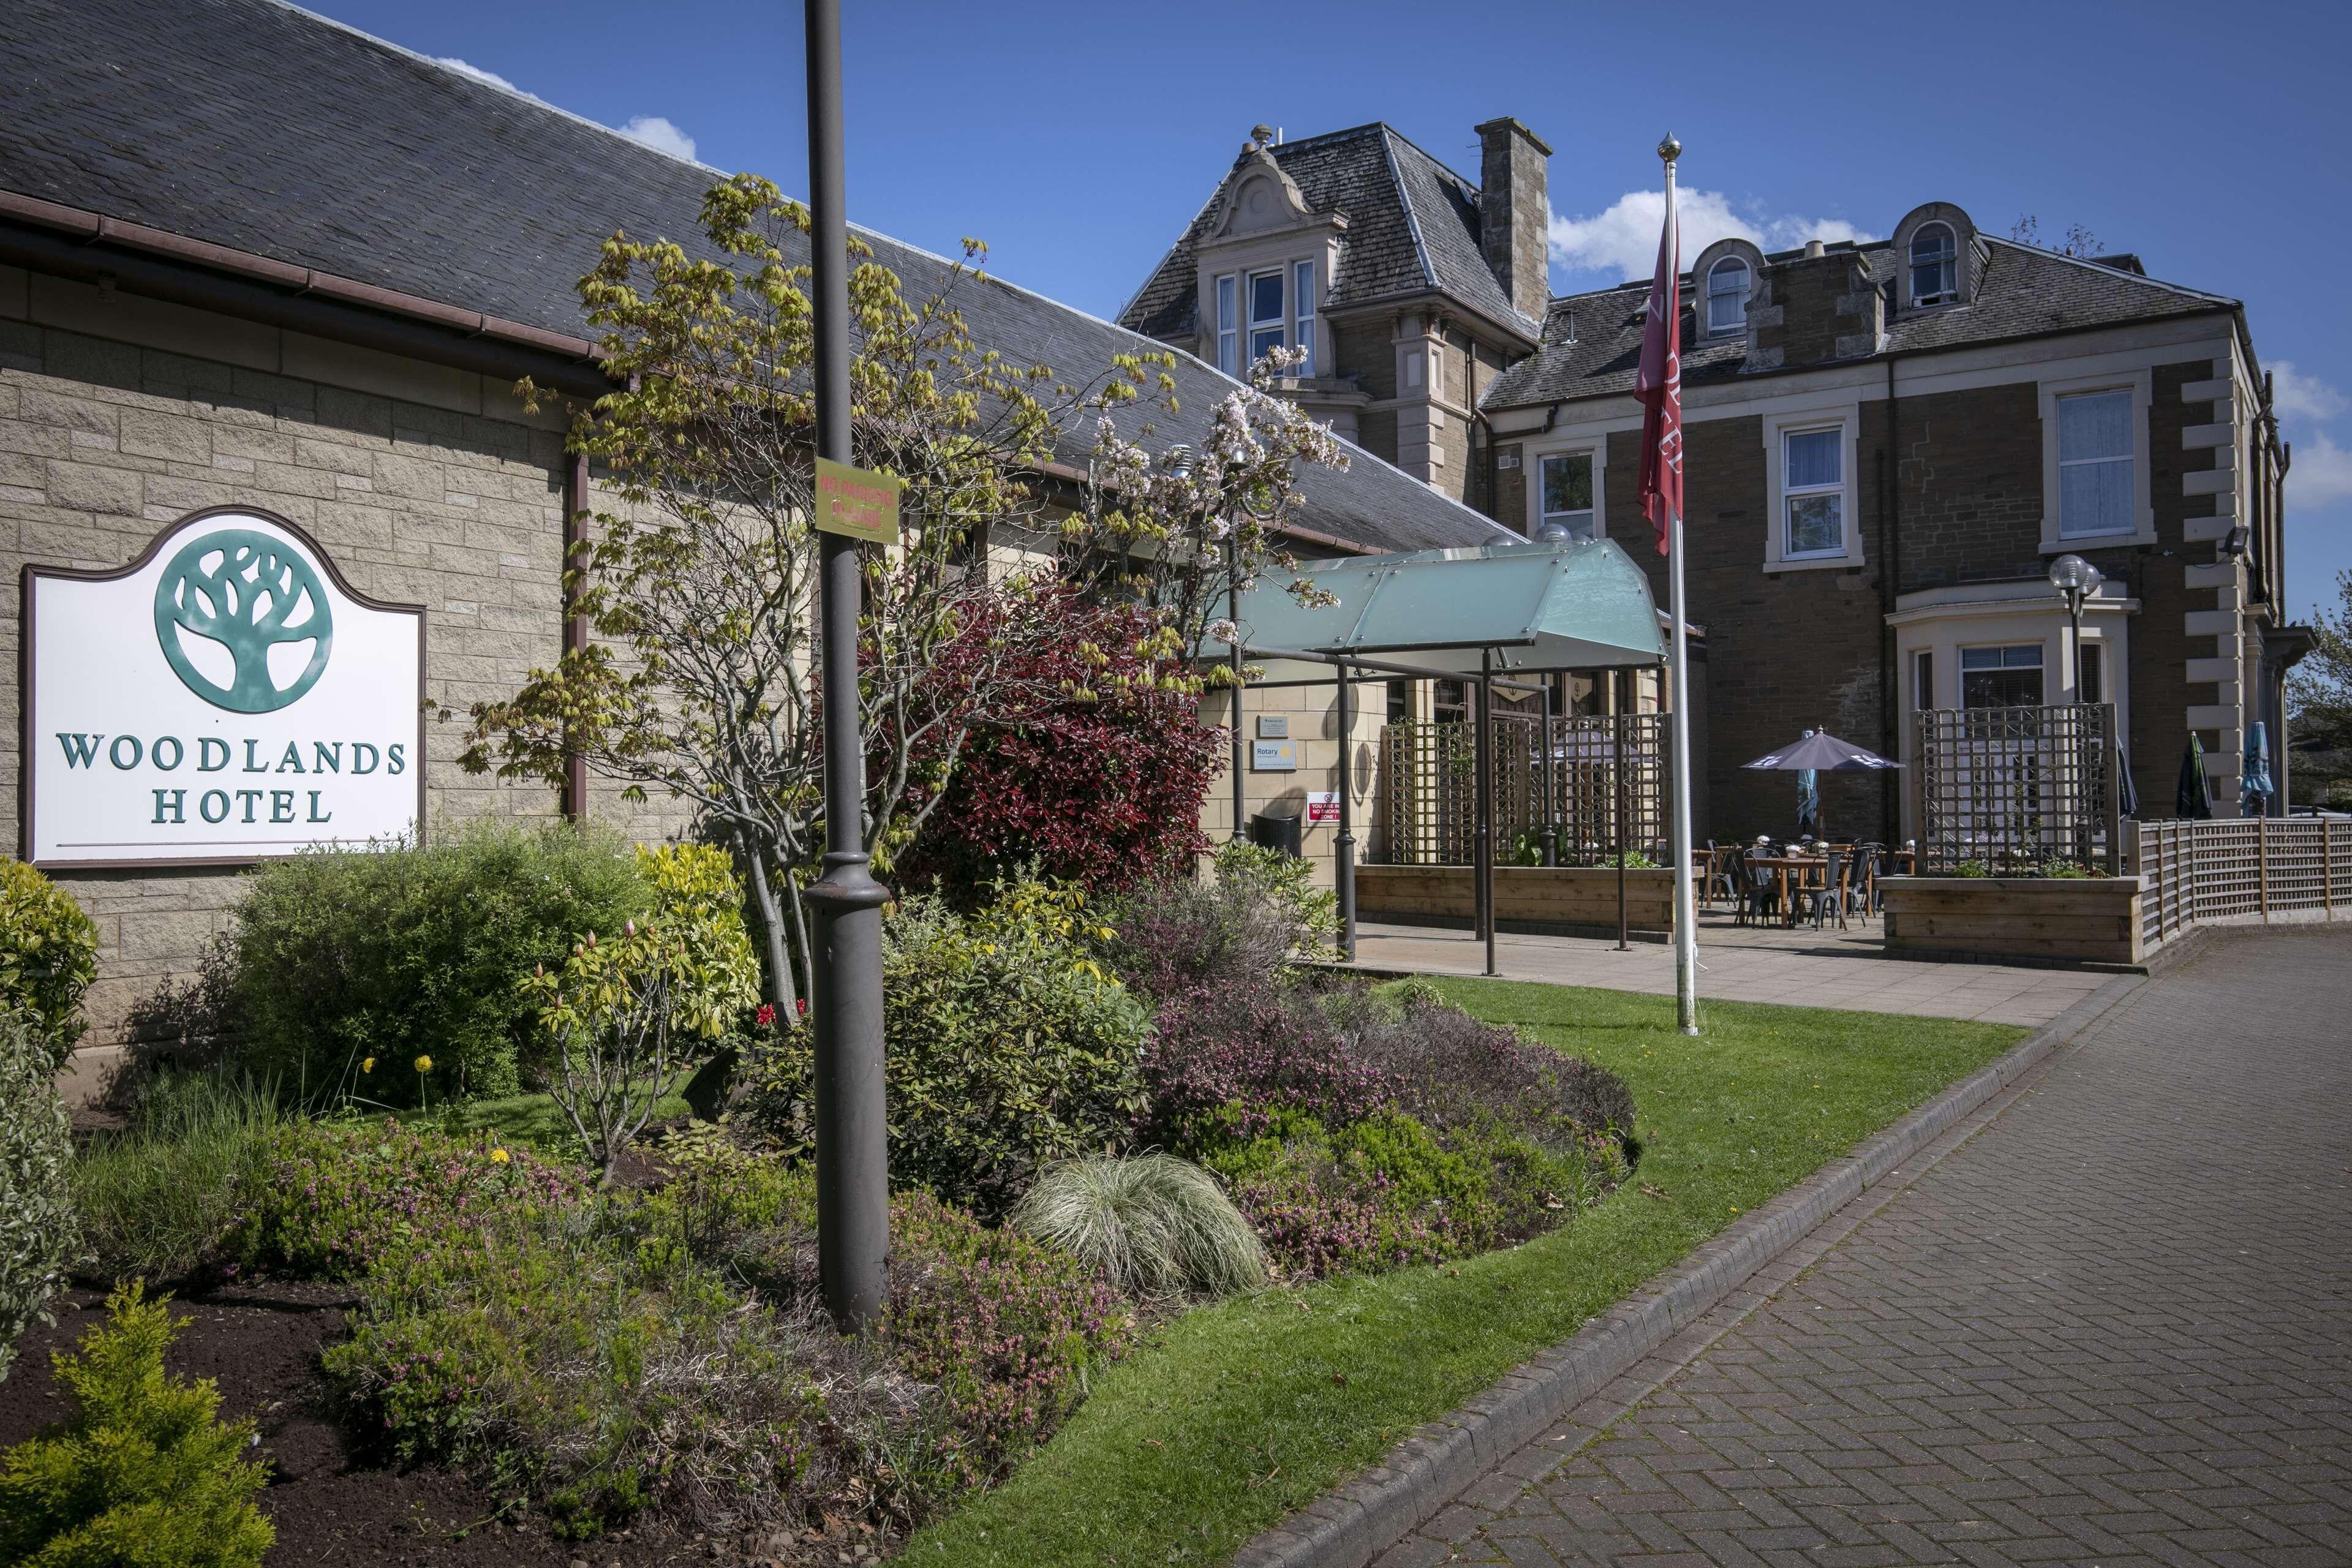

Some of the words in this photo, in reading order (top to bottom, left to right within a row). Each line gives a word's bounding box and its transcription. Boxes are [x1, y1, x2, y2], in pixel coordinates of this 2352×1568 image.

[820, 475, 839, 494] NO
[841, 480, 894, 508] PARKING
[833, 502, 881, 529] PLEASE
[56, 733, 406, 775] WOODLANDS
[151, 788, 333, 824] HOTEL
